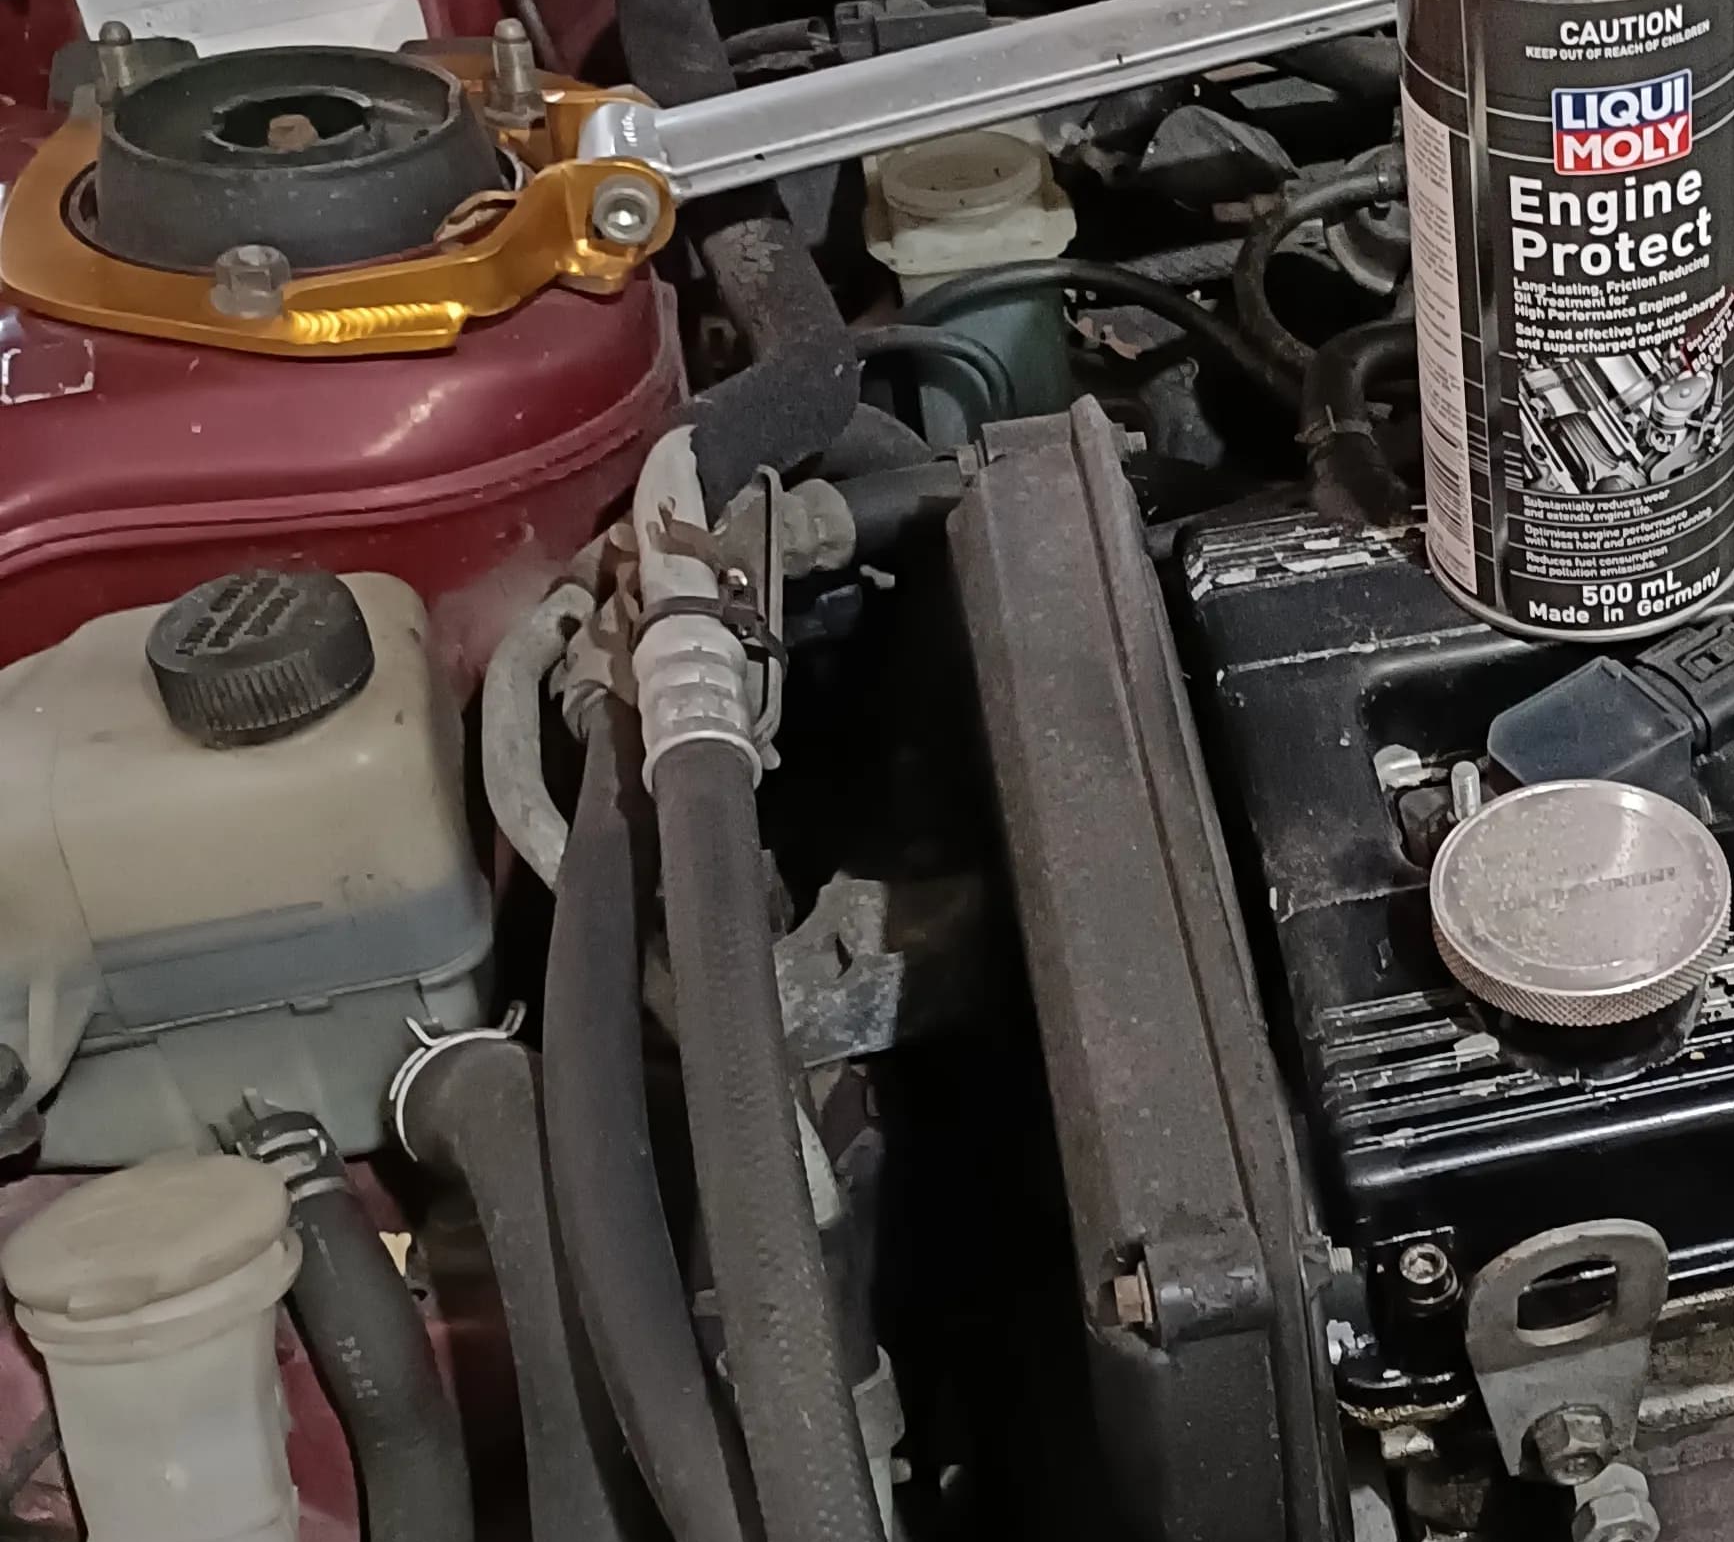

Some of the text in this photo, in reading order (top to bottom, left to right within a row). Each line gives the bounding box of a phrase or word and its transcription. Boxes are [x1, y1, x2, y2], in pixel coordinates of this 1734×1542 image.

[1526, 19, 1710, 60] KEEP OUT OF REACH OF CHILDREN
[1560, 4, 1683, 45] CAUTION
[1561, 77, 1685, 129] LIQUI
[1562, 114, 1688, 170] MOLY
[1509, 169, 1702, 236] Engine
[1511, 206, 1712, 276] Protect
[1513, 254, 1710, 297] Long-lasting, Friction Reducing
[1513, 291, 1629, 309] Oil Treatment for
[1514, 291, 1688, 322] High Performance Engines
[1515, 285, 1726, 341] Safe and effective for turbocharged
[1516, 324, 1686, 355] and supercharged engines
[1522, 489, 1670, 513] Substantially reduces wear
[1523, 506, 1653, 524] and extends engine life.
[1524, 510, 1688, 541] Optimises engine performance
[1524, 507, 1713, 550] with less heat and smoother running
[1525, 545, 1669, 568] Reduces fuel consumption
[1526, 560, 1658, 578] and pollution emissions.
[1528, 566, 1721, 624] Made in Germany
[1582, 570, 1682, 607] 500 mL
